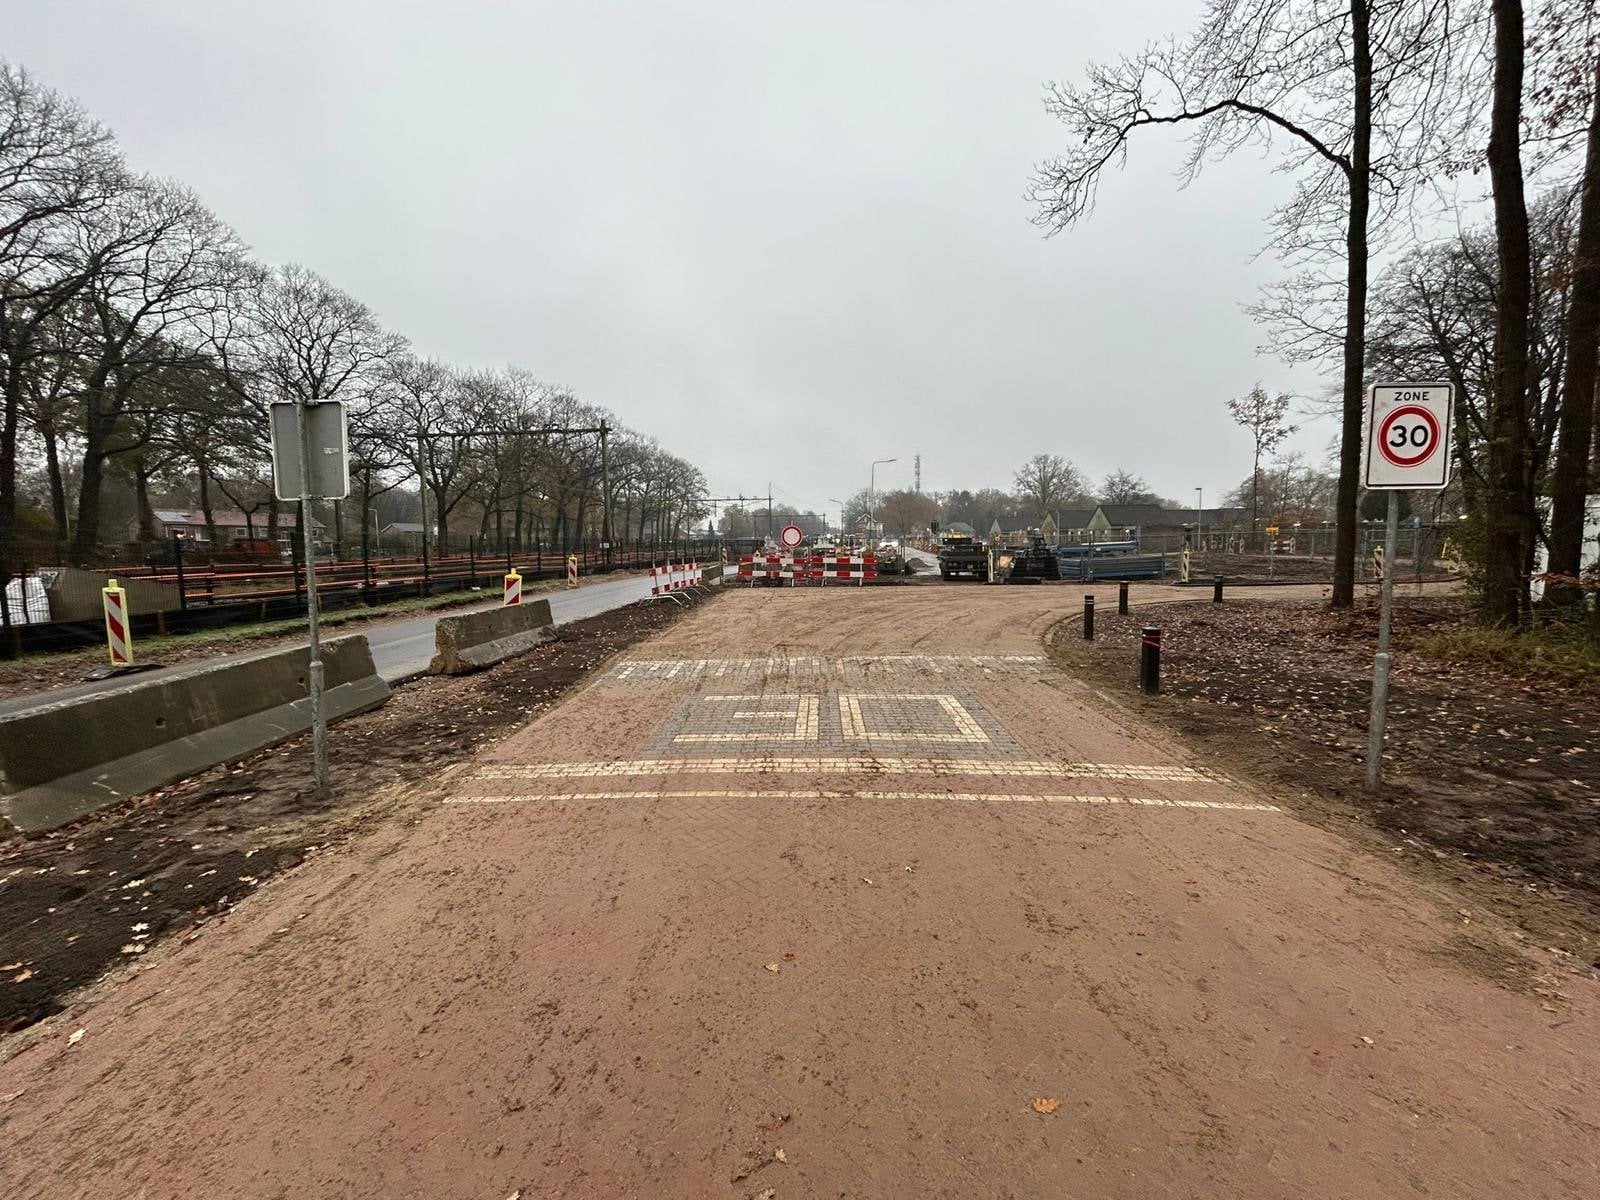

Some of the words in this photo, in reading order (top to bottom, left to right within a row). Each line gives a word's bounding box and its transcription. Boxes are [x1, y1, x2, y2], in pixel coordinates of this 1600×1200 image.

[1394, 391, 1430, 401] ZONE
[1389, 425, 1429, 447] 30
[673, 694, 992, 743] 30
